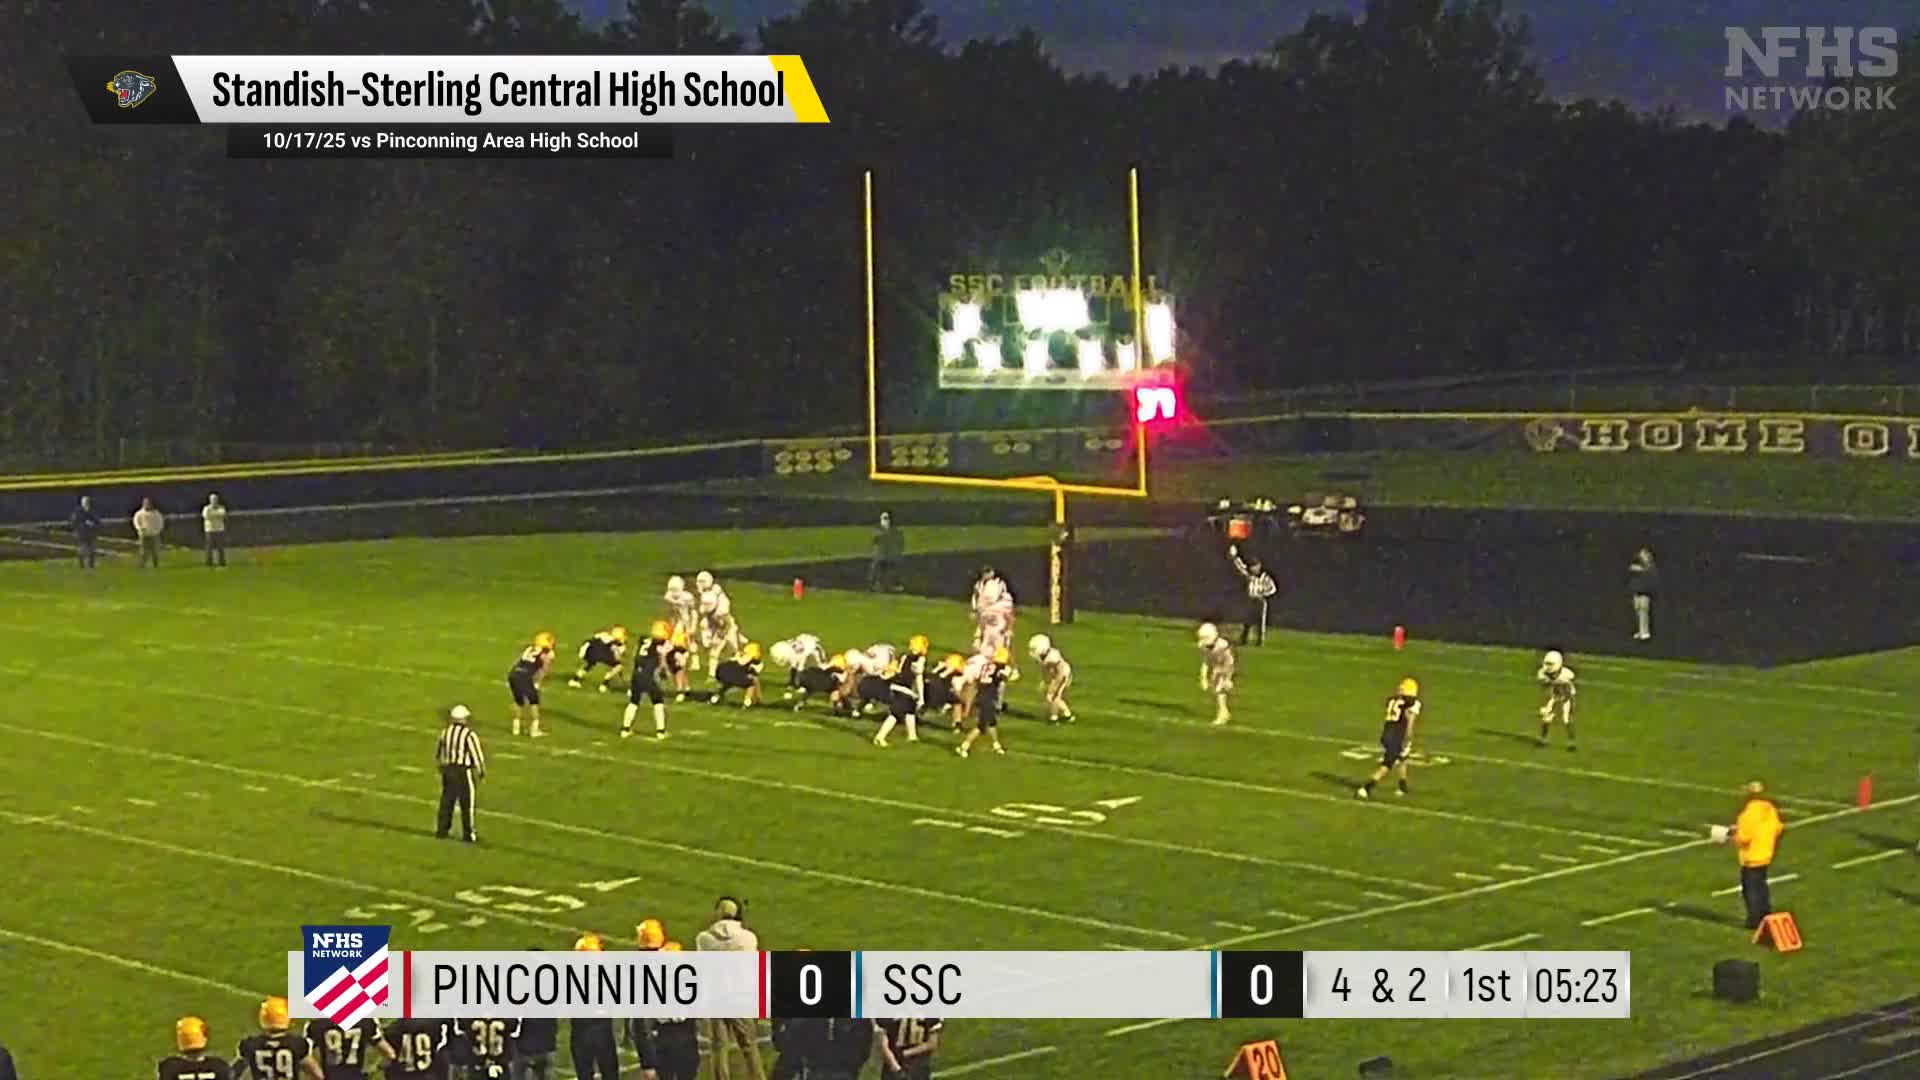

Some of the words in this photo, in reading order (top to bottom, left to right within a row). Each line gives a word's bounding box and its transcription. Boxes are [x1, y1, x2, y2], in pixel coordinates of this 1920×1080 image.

[950, 274, 1003, 293] SSC
[1579, 418, 1805, 452] HOME
[1384, 698, 1405, 722] 15
[324, 1028, 361, 1065] 97
[471, 1020, 504, 1056] 36
[255, 1049, 293, 1080] 59
